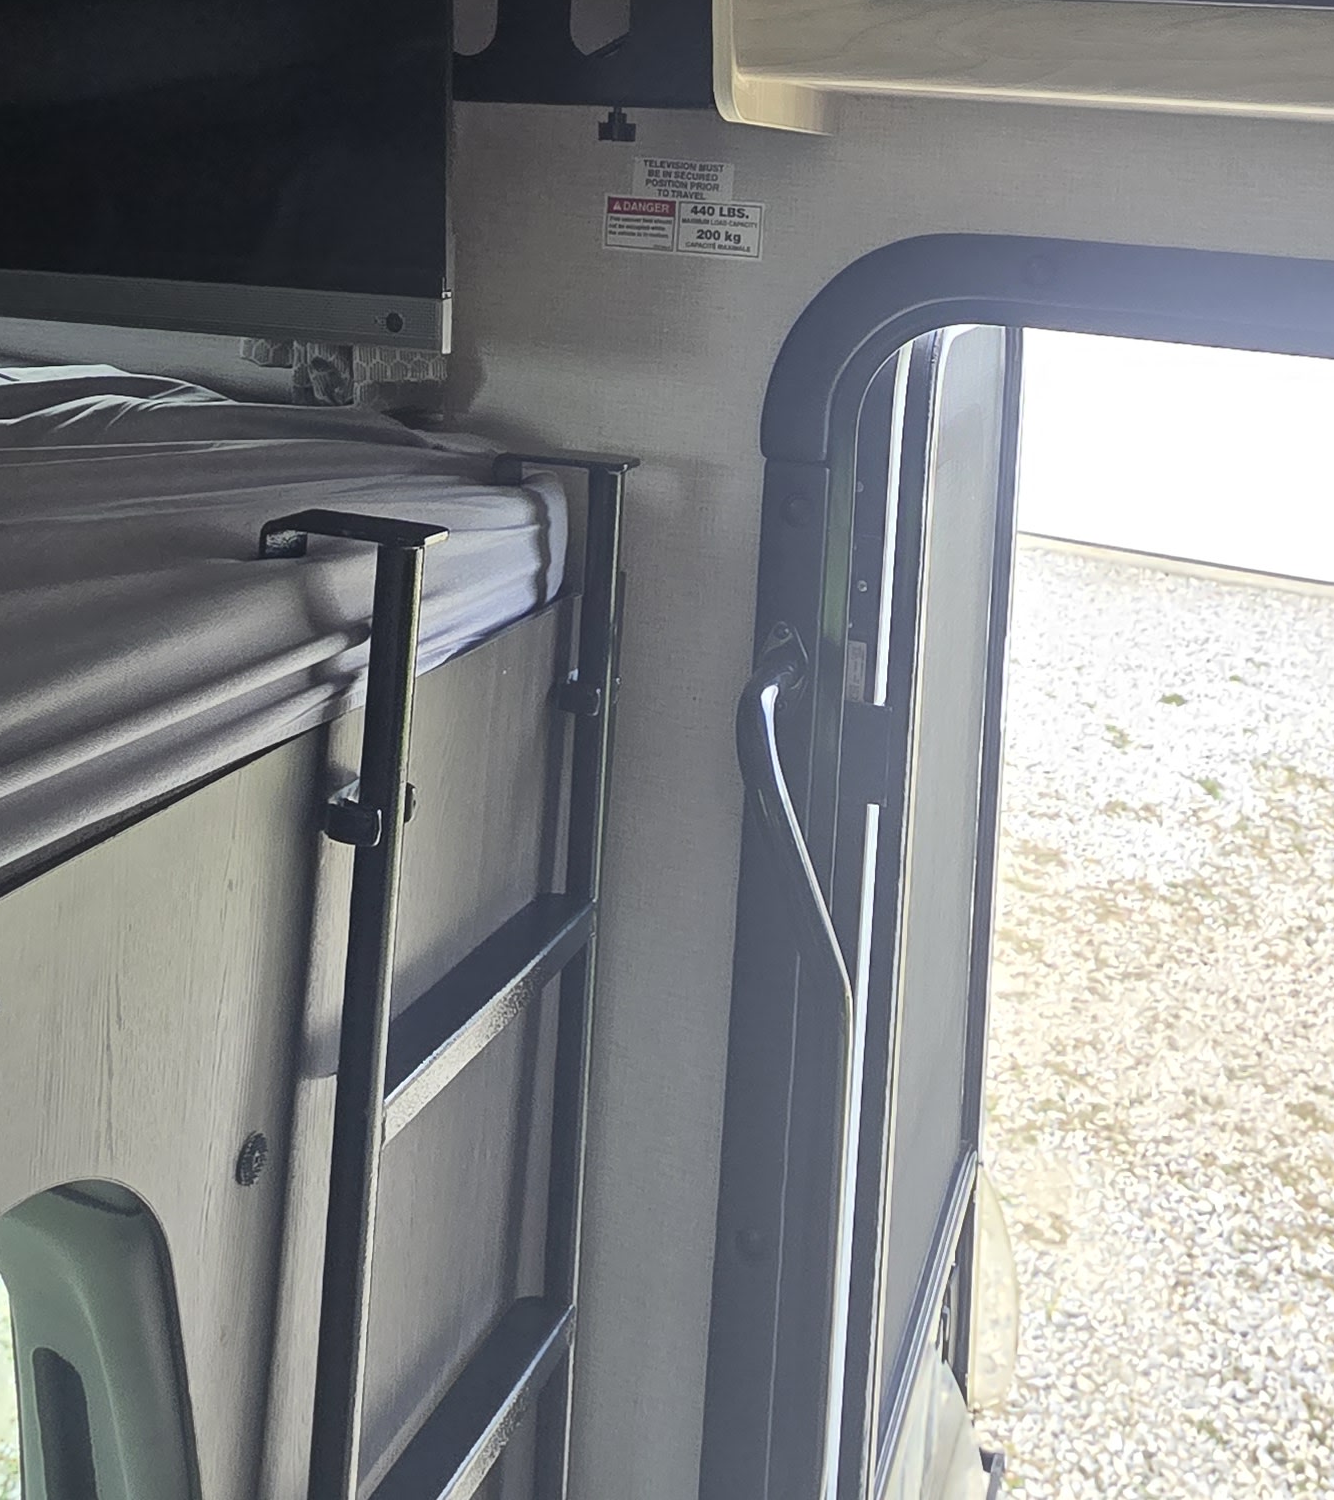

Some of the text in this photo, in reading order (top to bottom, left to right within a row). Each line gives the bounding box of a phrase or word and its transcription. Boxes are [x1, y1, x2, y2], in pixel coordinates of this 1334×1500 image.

[643, 159, 725, 173] TELEVISION MUST
[647, 169, 719, 182] BE IN SECURED
[645, 178, 721, 192] POSITION PRIOR
[657, 188, 707, 201] TO TRAVEL
[623, 203, 670, 214] DANGER
[690, 205, 750, 219] 440 LBS.
[696, 229, 742, 245] 200 kg
